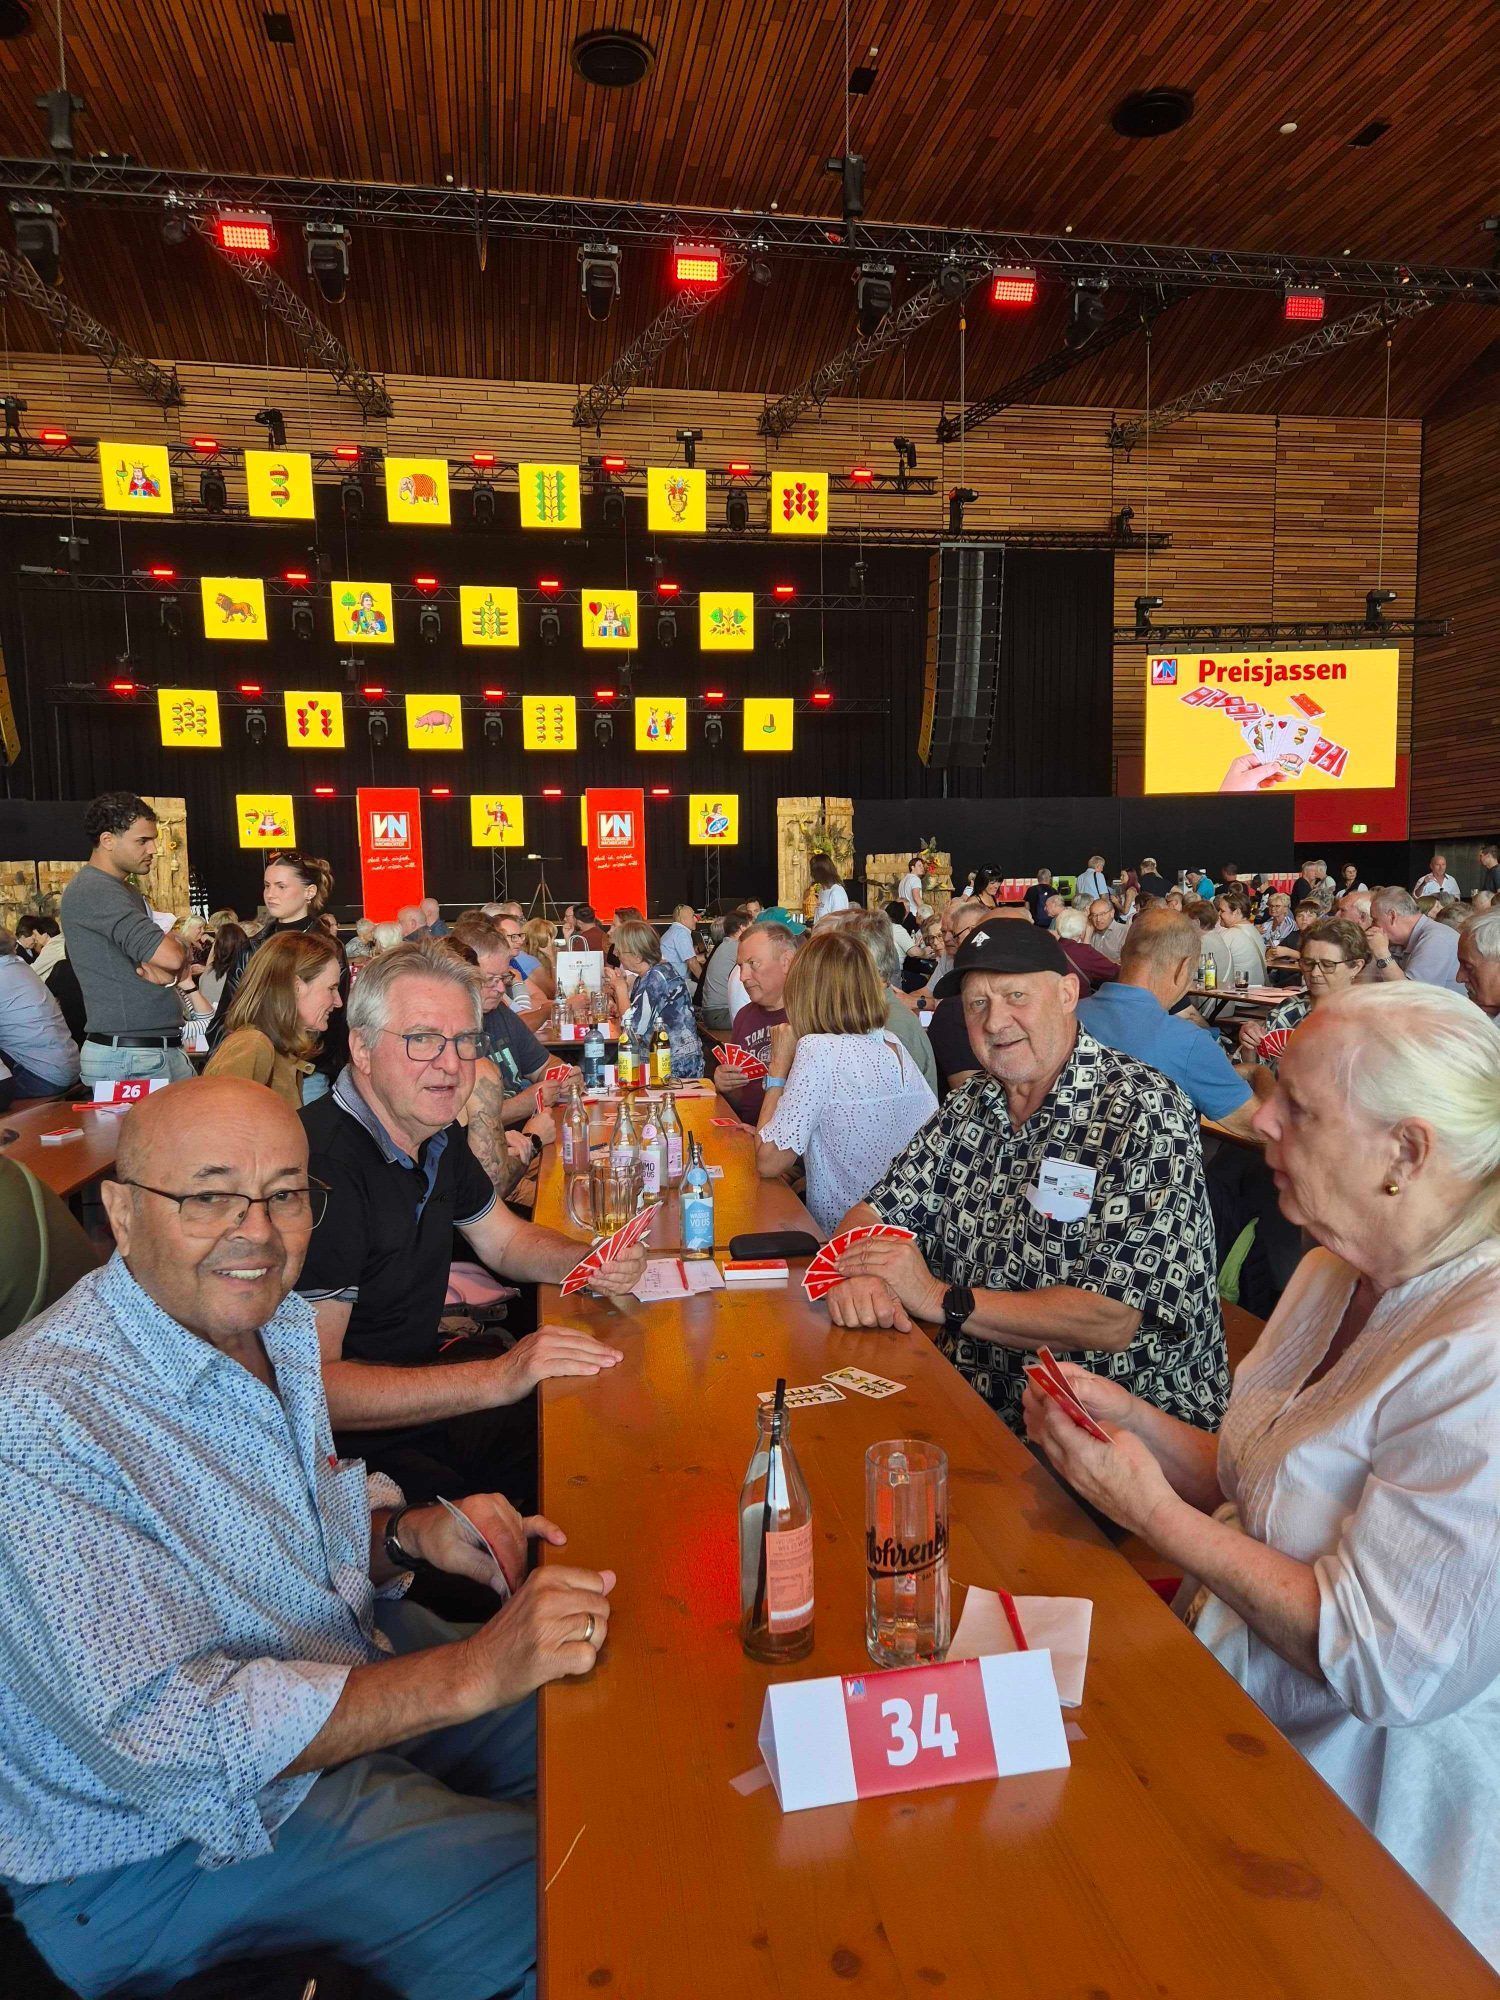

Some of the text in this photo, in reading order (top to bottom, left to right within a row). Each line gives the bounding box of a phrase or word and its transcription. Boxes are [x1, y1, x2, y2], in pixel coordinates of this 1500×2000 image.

[1199, 658, 1347, 687] Preisjassen
[373, 814, 407, 837] VN
[600, 814, 632, 837] VN
[744, 1028, 765, 1046] TOM
[122, 1085, 141, 1098] 26
[690, 1217, 710, 1227] VO US
[882, 1693, 959, 1766] 34
